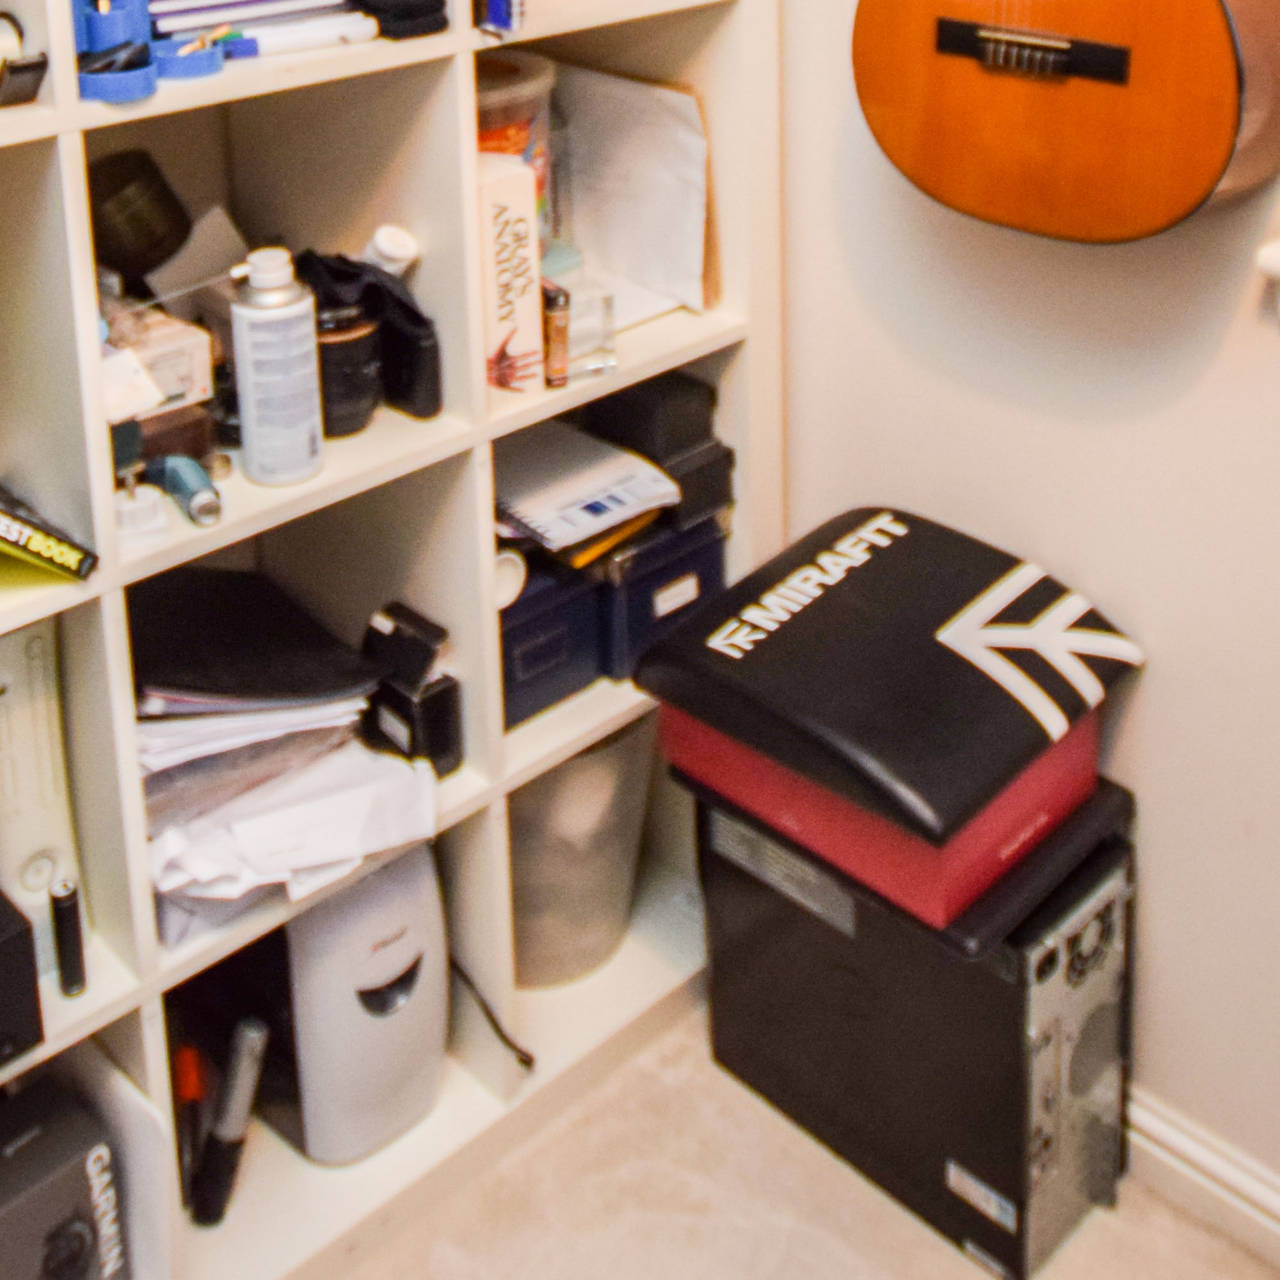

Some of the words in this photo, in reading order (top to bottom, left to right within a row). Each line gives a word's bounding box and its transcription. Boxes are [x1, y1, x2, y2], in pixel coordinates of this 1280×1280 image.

[492, 204, 515, 322] ANATOMY
[26, 528, 86, 572] BOOK
[739, 510, 910, 632] MIRAFIT
[85, 1142, 125, 1279] GARMIN
